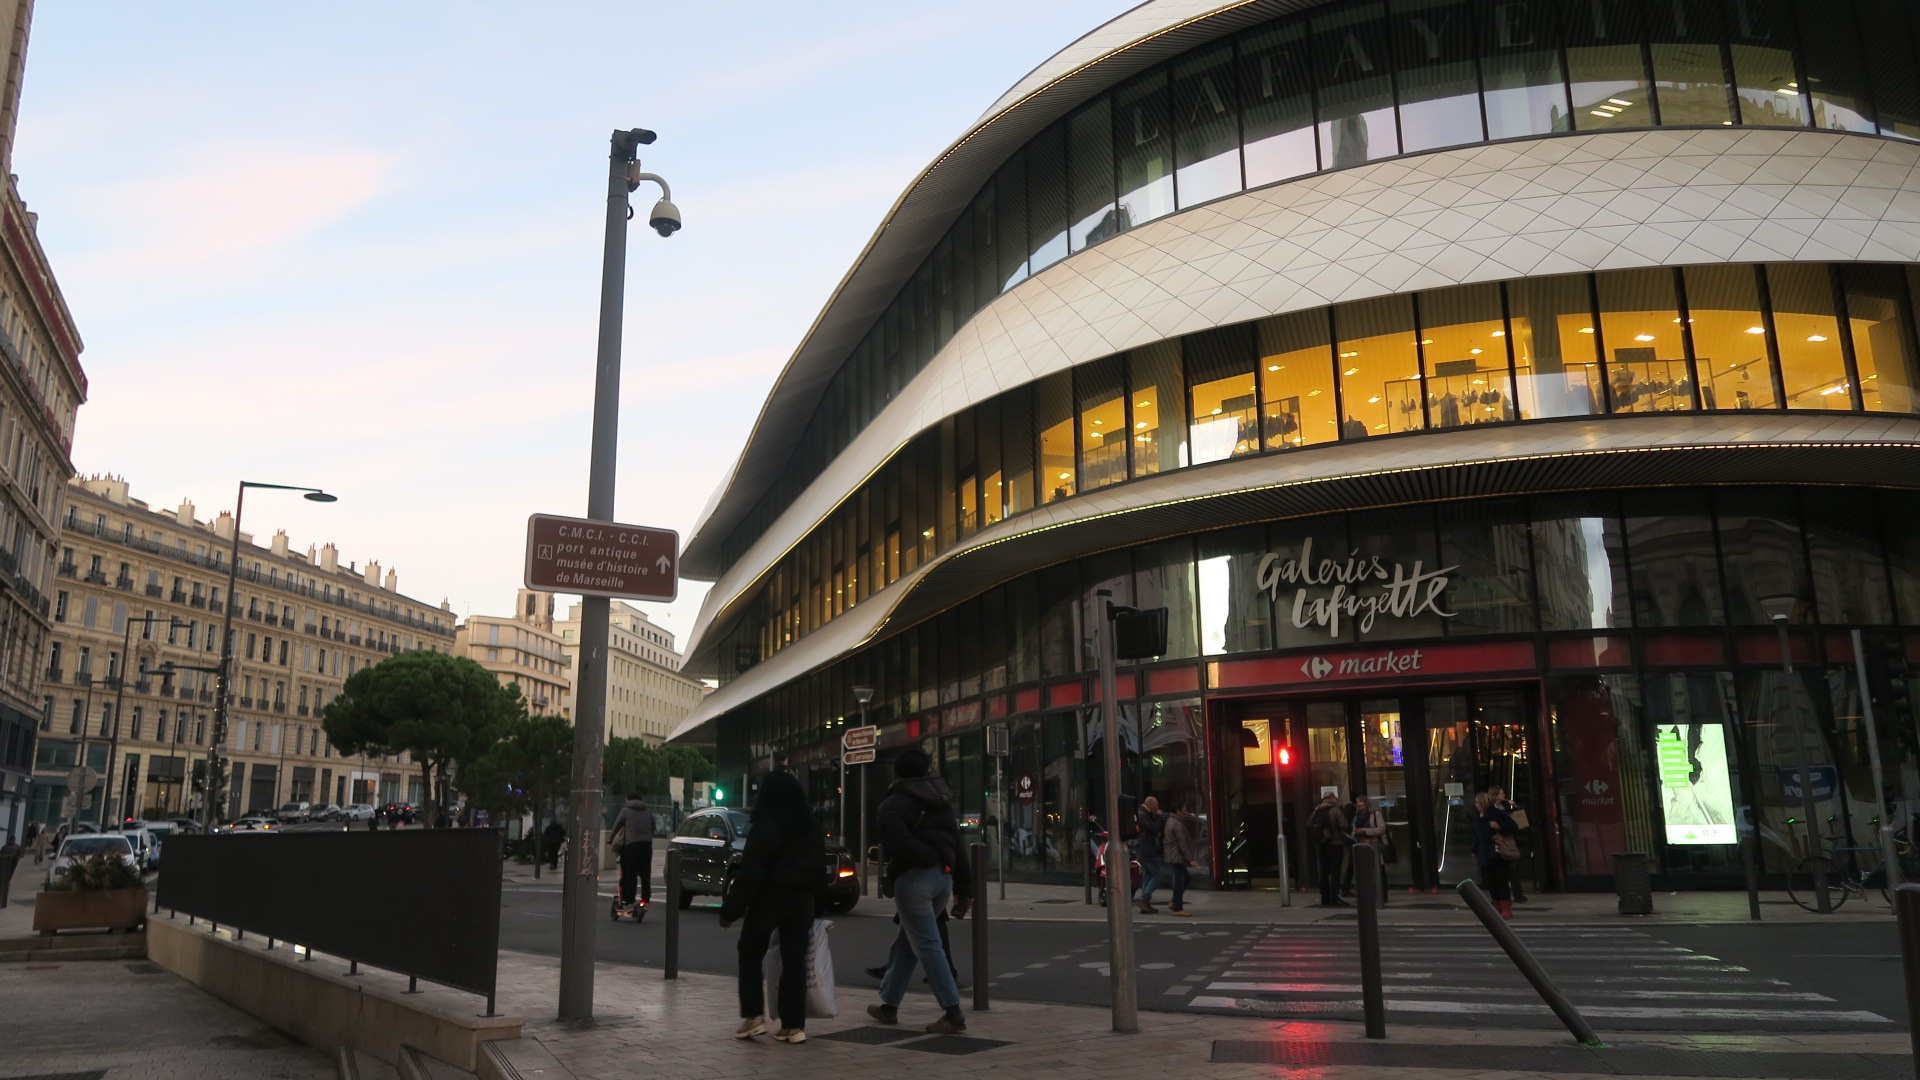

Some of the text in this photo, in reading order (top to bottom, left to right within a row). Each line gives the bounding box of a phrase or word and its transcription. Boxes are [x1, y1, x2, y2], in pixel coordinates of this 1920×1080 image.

[558, 525, 605, 541] C.M.C.I.
[618, 532, 649, 546] C.C.I.
[556, 543, 637, 560] port antique
[556, 558, 649, 576] musée d'histoire
[1256, 536, 1389, 602] Galeries
[556, 572, 625, 588] de Marseille
[1291, 560, 1461, 638] Lafayette
[1339, 649, 1423, 674] market
[1582, 796, 1615, 806] market
